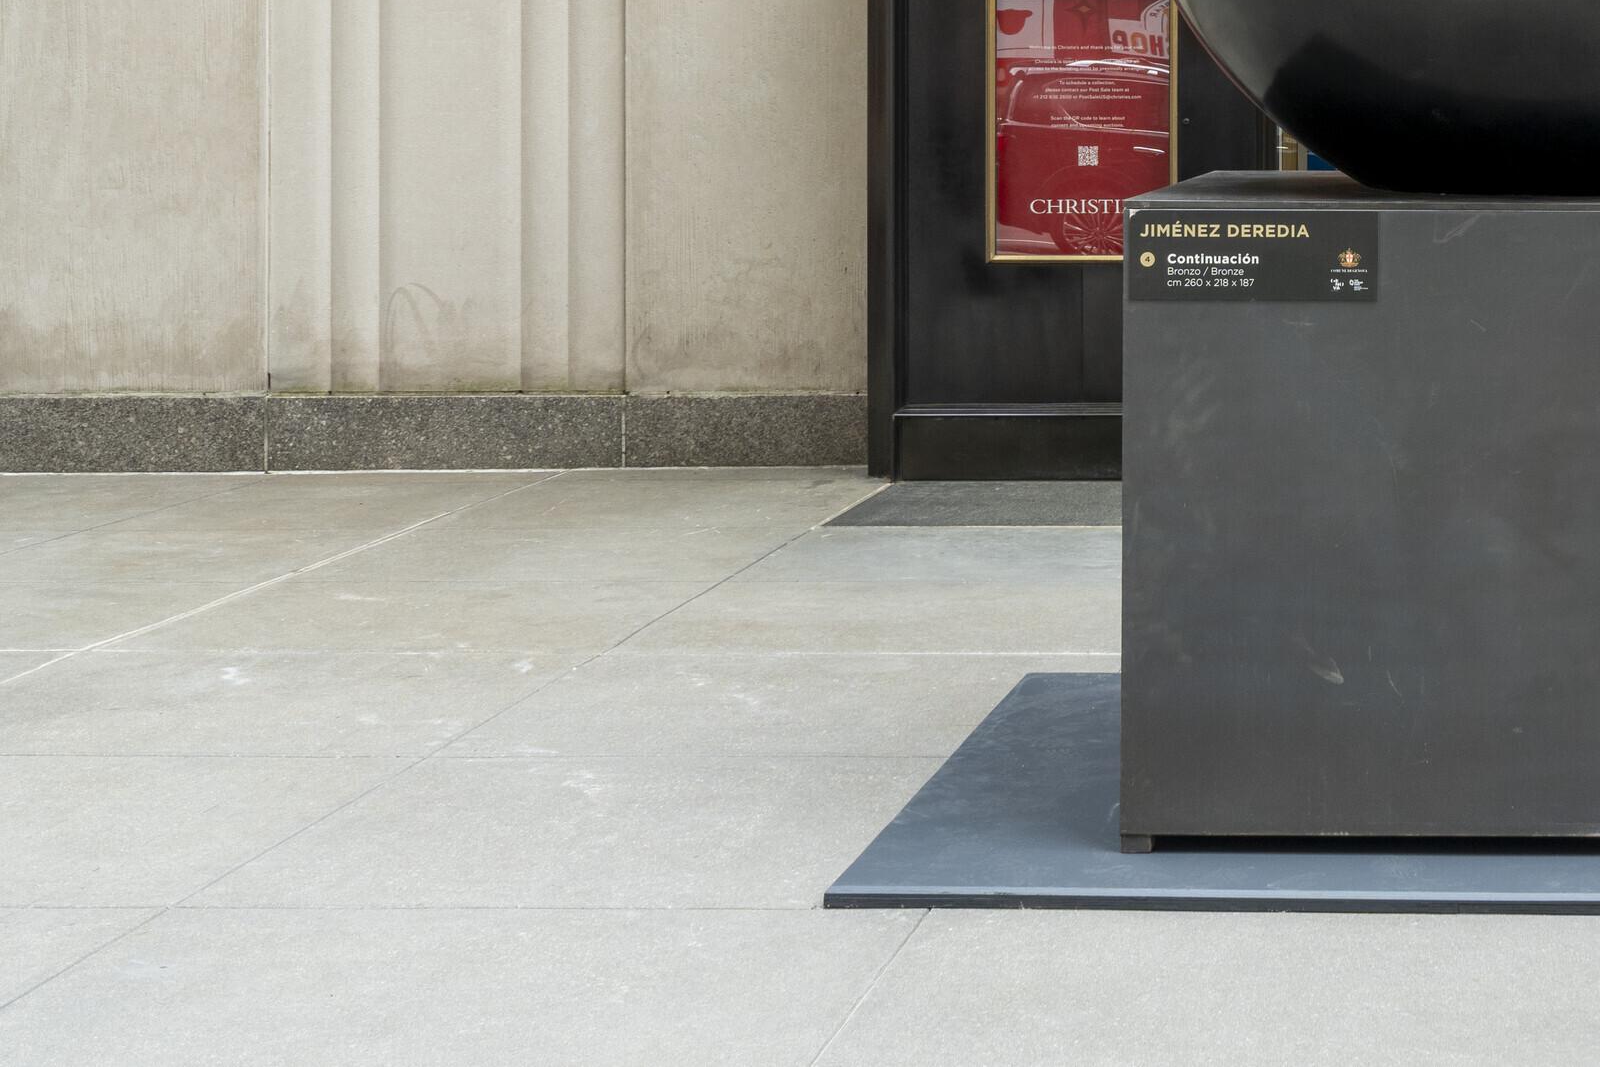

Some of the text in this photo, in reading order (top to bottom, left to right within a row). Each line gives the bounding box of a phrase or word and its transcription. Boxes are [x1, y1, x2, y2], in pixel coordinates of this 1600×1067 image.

[1030, 198, 1123, 215] CHRISTI
[1140, 220, 1310, 238] JIMÉNEZ DEREDIA
[1167, 253, 1260, 265] Continuación
[1167, 266, 1201, 276] Bronzo
[1211, 266, 1245, 276] Bronze
[1184, 278, 1203, 287] 260
[1214, 278, 1228, 287] 218
[1239, 278, 1255, 287] 187
